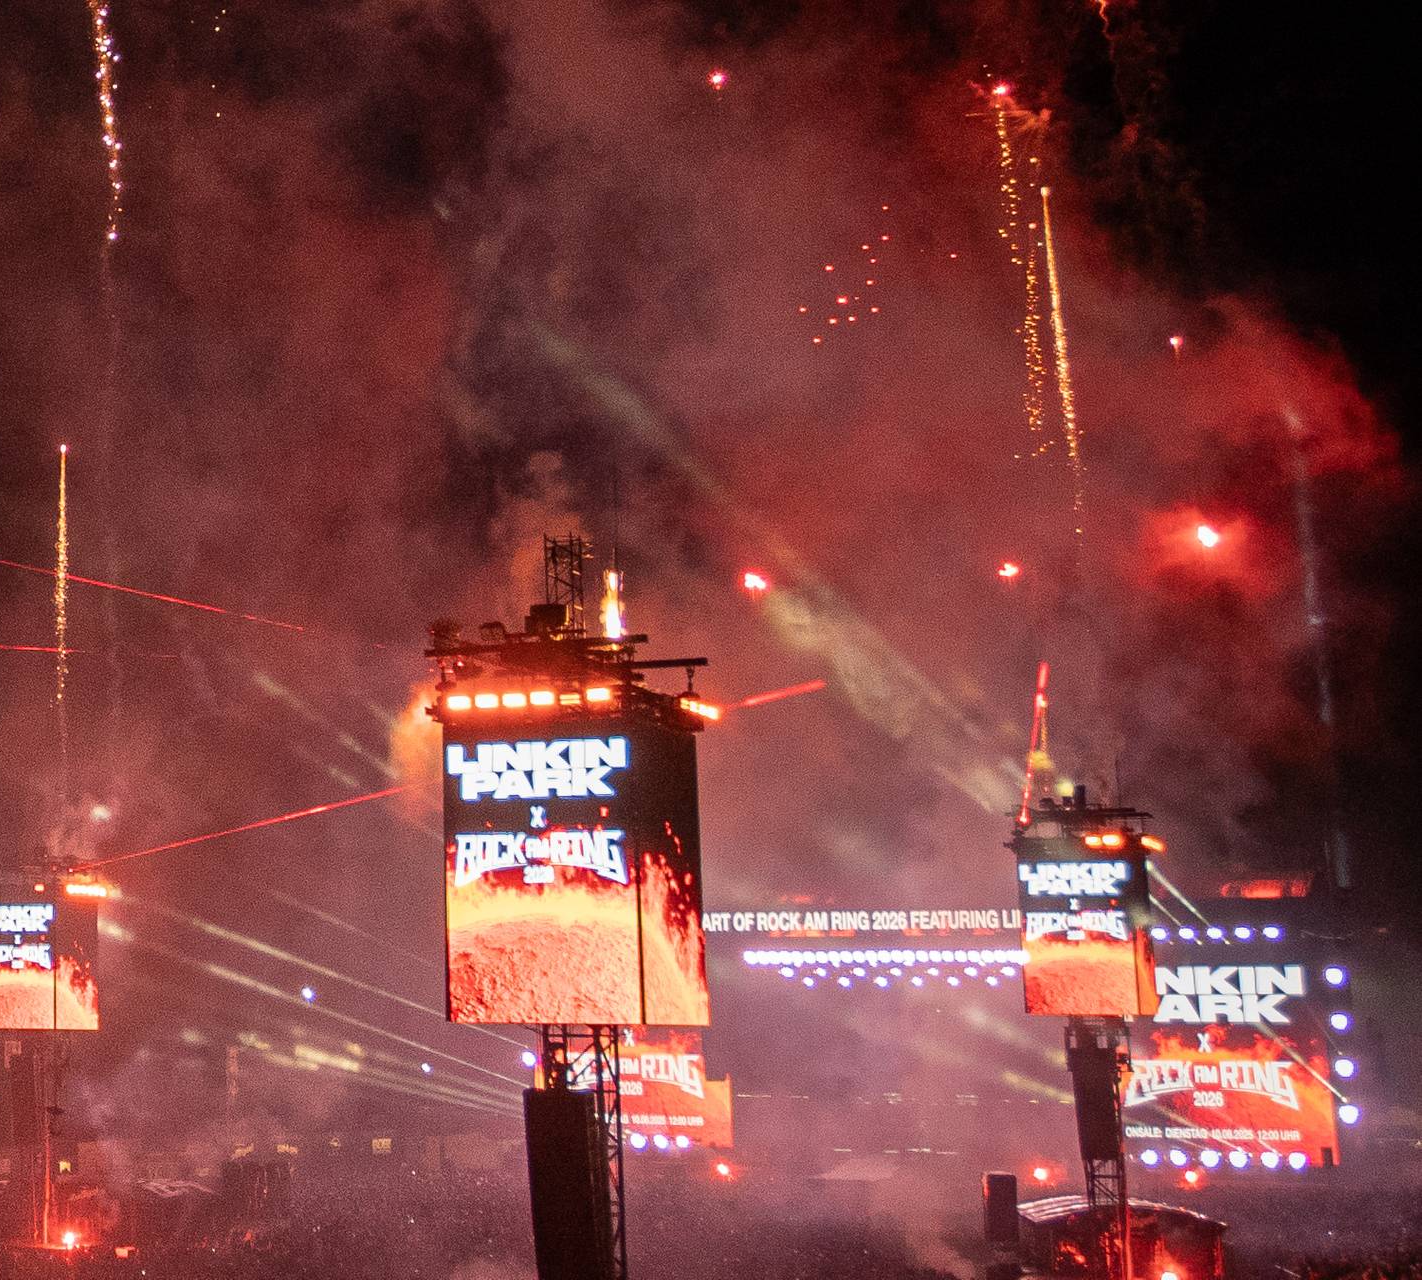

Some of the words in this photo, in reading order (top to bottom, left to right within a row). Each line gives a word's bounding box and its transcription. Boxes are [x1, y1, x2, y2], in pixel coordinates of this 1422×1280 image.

[446, 737, 627, 774] LINKIN
[460, 767, 616, 800] PARK
[454, 832, 526, 887] ROCK
[550, 830, 628, 885] RING
[1018, 862, 1126, 881] LINKIN
[1028, 879, 1119, 895] PARK
[733, 912, 755, 931] OF
[757, 911, 802, 931] ROCK
[803, 911, 828, 931] AM
[830, 911, 870, 931] RING
[872, 911, 907, 930] 2026
[910, 909, 999, 930] FEATURING
[1123, 994, 1291, 1023] ARK
[619, 1057, 640, 1075] AM
[641, 1054, 705, 1099] RING
[1124, 1060, 1194, 1107] ROCK
[1194, 1065, 1219, 1084] AM
[1219, 1060, 1300, 1110] RING
[1193, 1091, 1225, 1107] 2026
[1125, 1126, 1162, 1139] ONSALE:
[1165, 1127, 1208, 1140] DIENSTAG
[1257, 1129, 1279, 1140] 12:00
[1280, 1130, 1301, 1141] UHR
